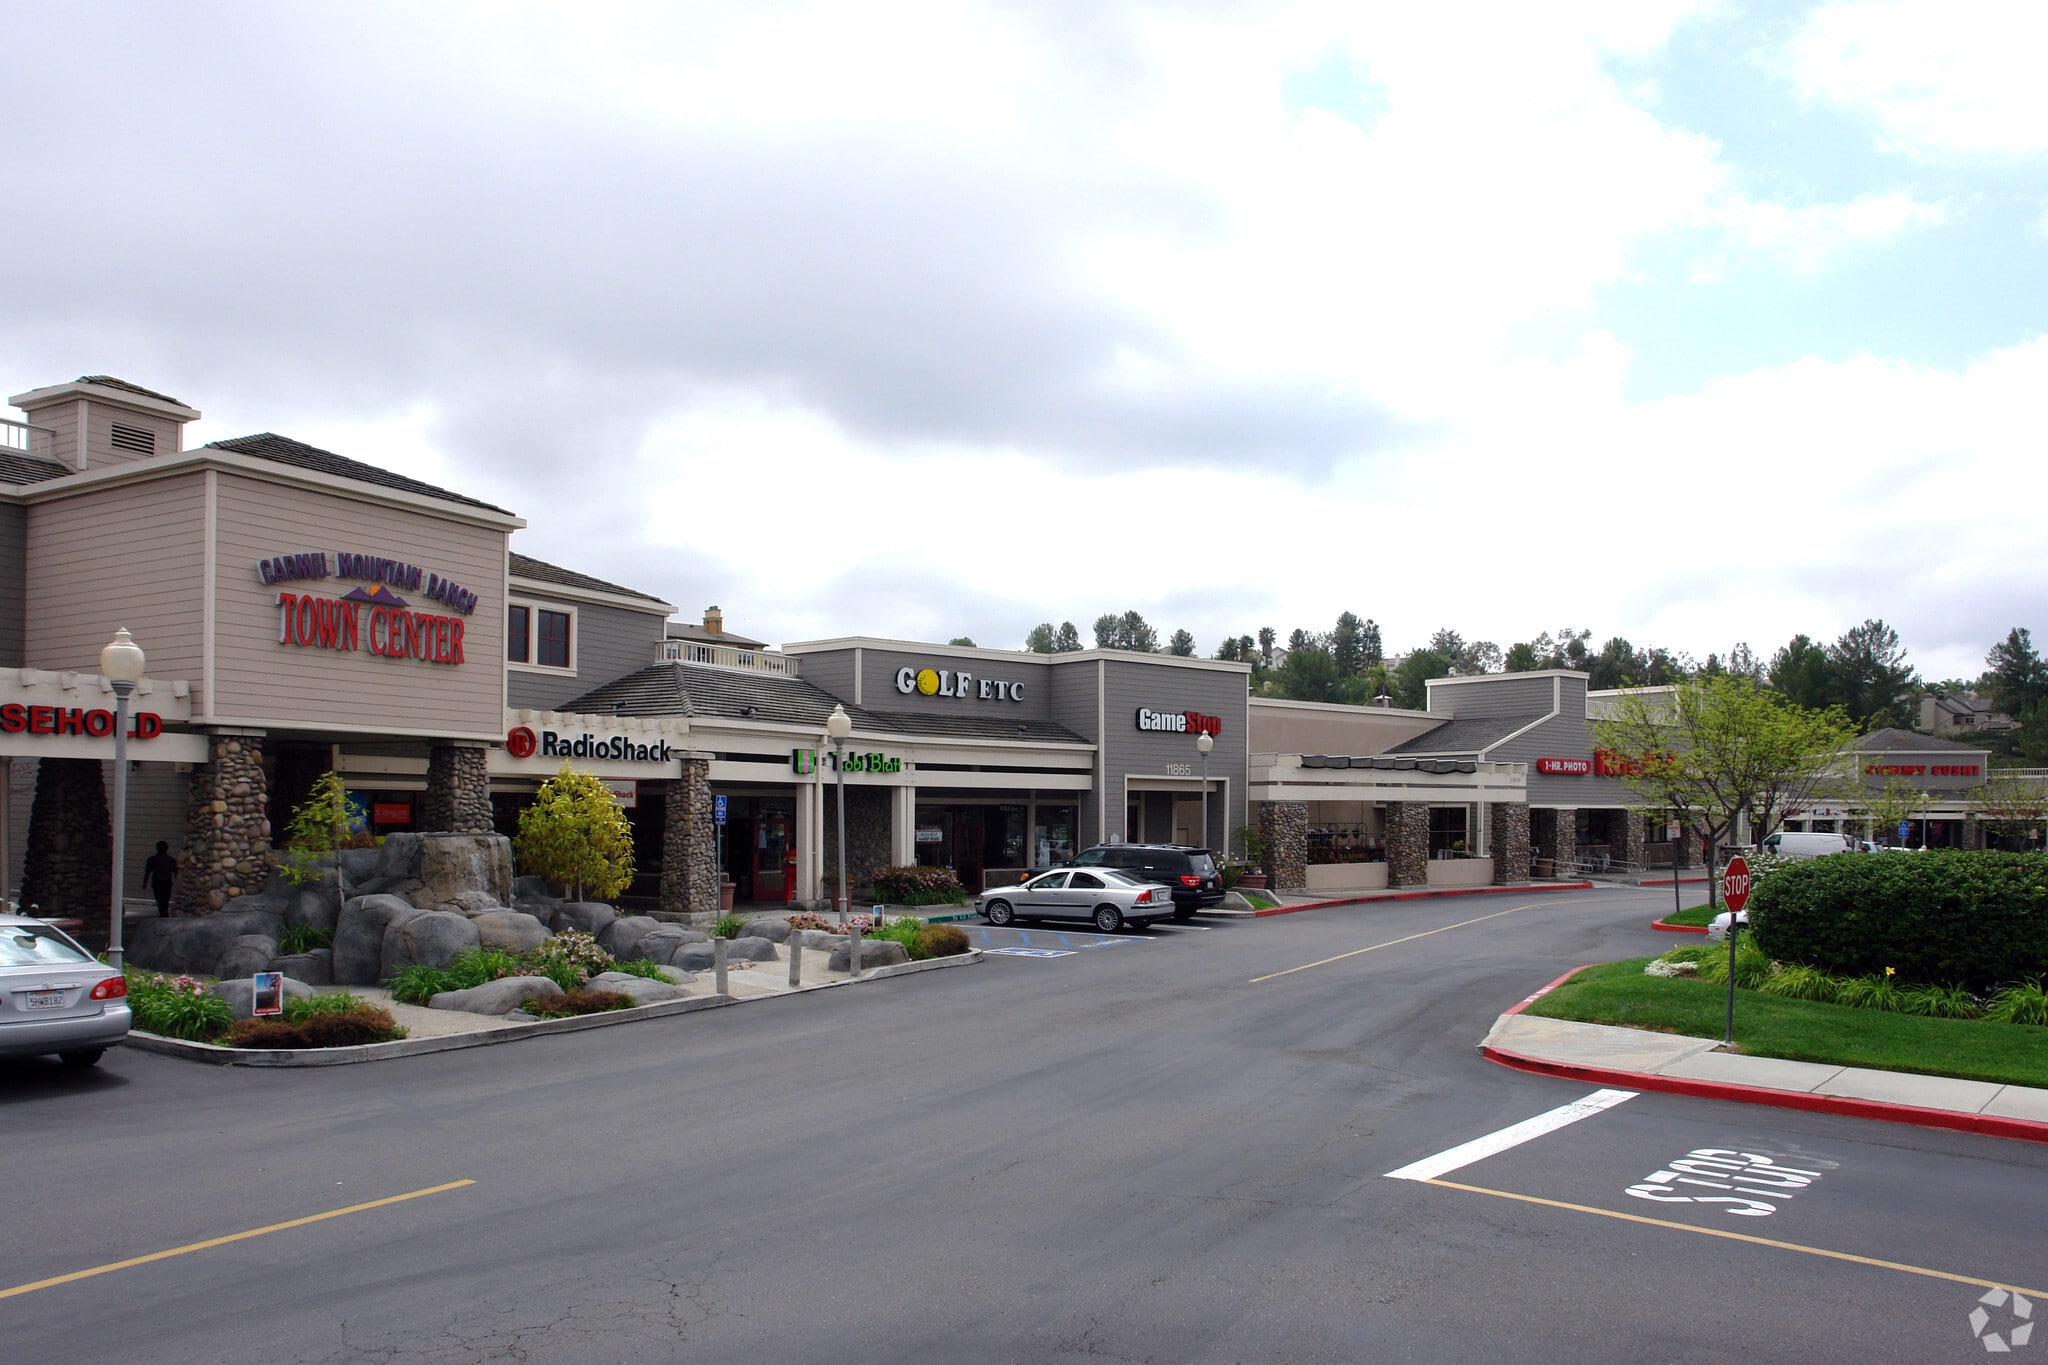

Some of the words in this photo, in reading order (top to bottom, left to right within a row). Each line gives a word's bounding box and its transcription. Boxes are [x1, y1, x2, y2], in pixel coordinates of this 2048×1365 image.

[257, 552, 331, 586] CARMEL
[334, 552, 423, 591] MOUNTAIN
[424, 572, 478, 616] RANCH
[275, 592, 360, 652] TOWN
[366, 605, 464, 665] CENTER
[896, 667, 972, 697] GOLF
[979, 679, 1025, 701] ETC
[0, 703, 163, 739] SEHOD
[1136, 707, 1222, 737] GameStop
[540, 731, 671, 762] RadioShack
[1166, 763, 1191, 776] 11865
[1563, 761, 1587, 772] PHOTO
[1931, 765, 1980, 776] SUSHI
[1725, 874, 1748, 897] STOP
[1625, 1148, 1823, 1217] STOP
